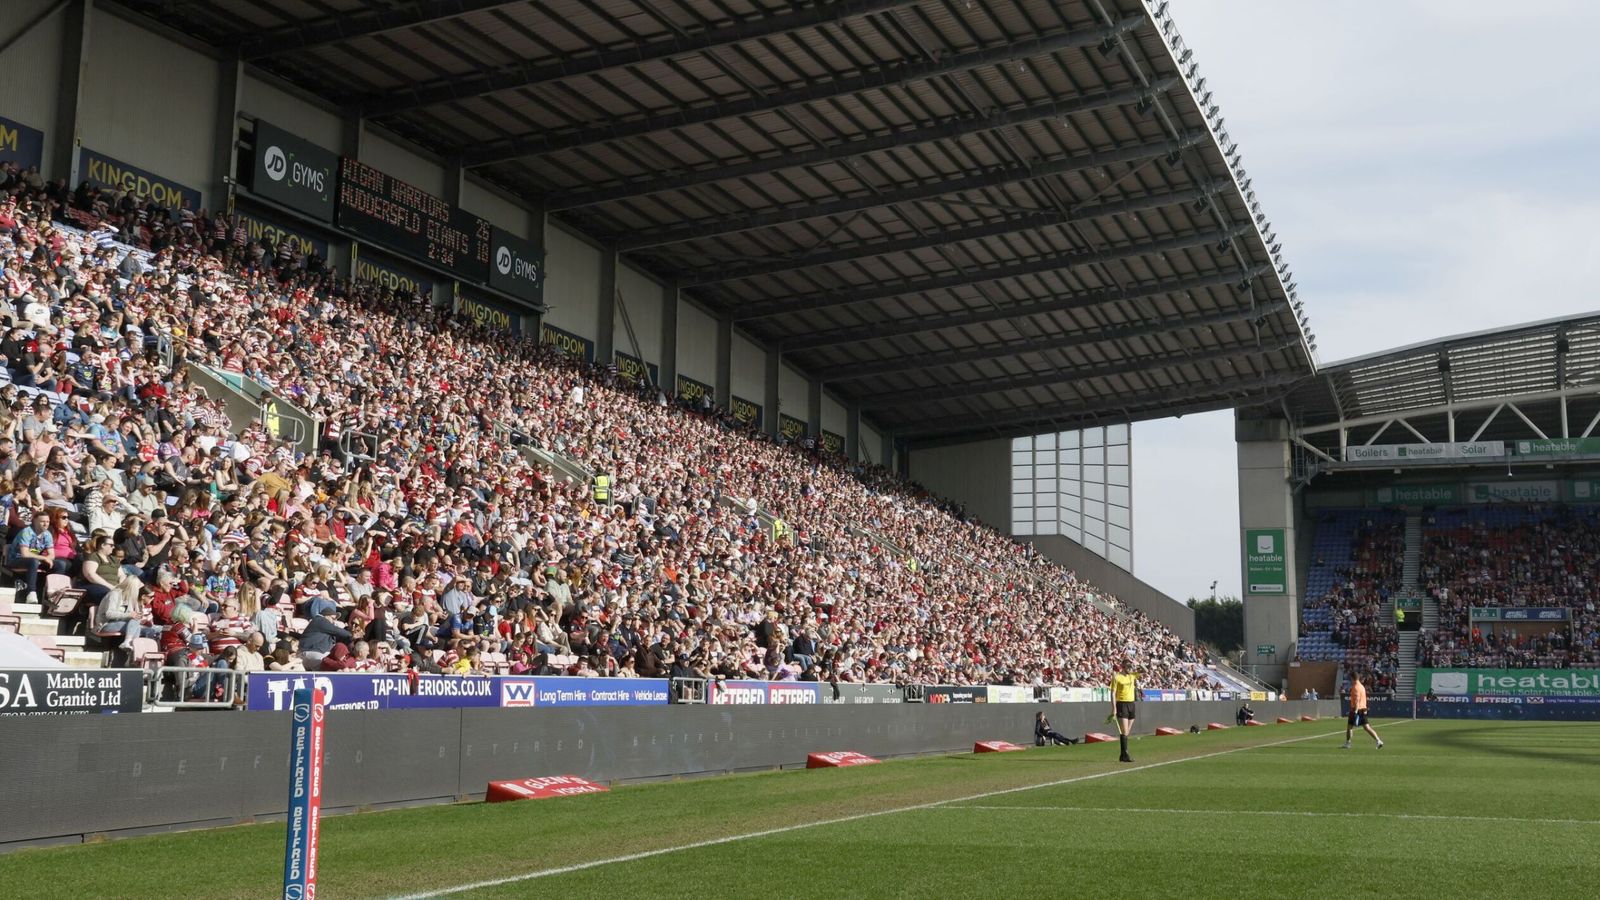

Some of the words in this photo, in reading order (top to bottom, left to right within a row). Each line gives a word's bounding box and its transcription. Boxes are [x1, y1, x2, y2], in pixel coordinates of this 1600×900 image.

[88, 158, 182, 209] KINGDOM
[266, 155, 285, 174] JD
[292, 162, 325, 192] GYMS
[343, 158, 384, 194] WIGAN
[391, 179, 449, 222] WARRIORS
[341, 182, 421, 233] HUDDERSFLD
[427, 220, 470, 255] GIANTS
[499, 254, 510, 268] JD
[515, 258, 537, 282] GYMS
[1355, 447, 1388, 458] Boilers
[1461, 443, 1487, 454] Solar
[1533, 441, 1577, 453] heatable
[1395, 487, 1452, 501] heatable
[1493, 484, 1552, 499] heatable
[1249, 554, 1283, 568] heatable
[46, 672, 95, 689] Marble
[98, 672, 121, 689] and
[372, 679, 491, 697] TAP-INERIORS.CO.UK
[46, 690, 97, 707] Granite
[100, 690, 121, 706] Ltd
[540, 690, 556, 704] Long
[557, 690, 574, 701] Term
[574, 690, 587, 702] Hire
[591, 690, 617, 702] Contract
[617, 690, 630, 701] Hire
[634, 690, 653, 701] Vehicle
[653, 691, 668, 701] Lease
[294, 726, 306, 798] BETFRED
[312, 726, 322, 797] BETFRED
[290, 806, 303, 880] BETFRED
[309, 806, 319, 880] BETFRED
